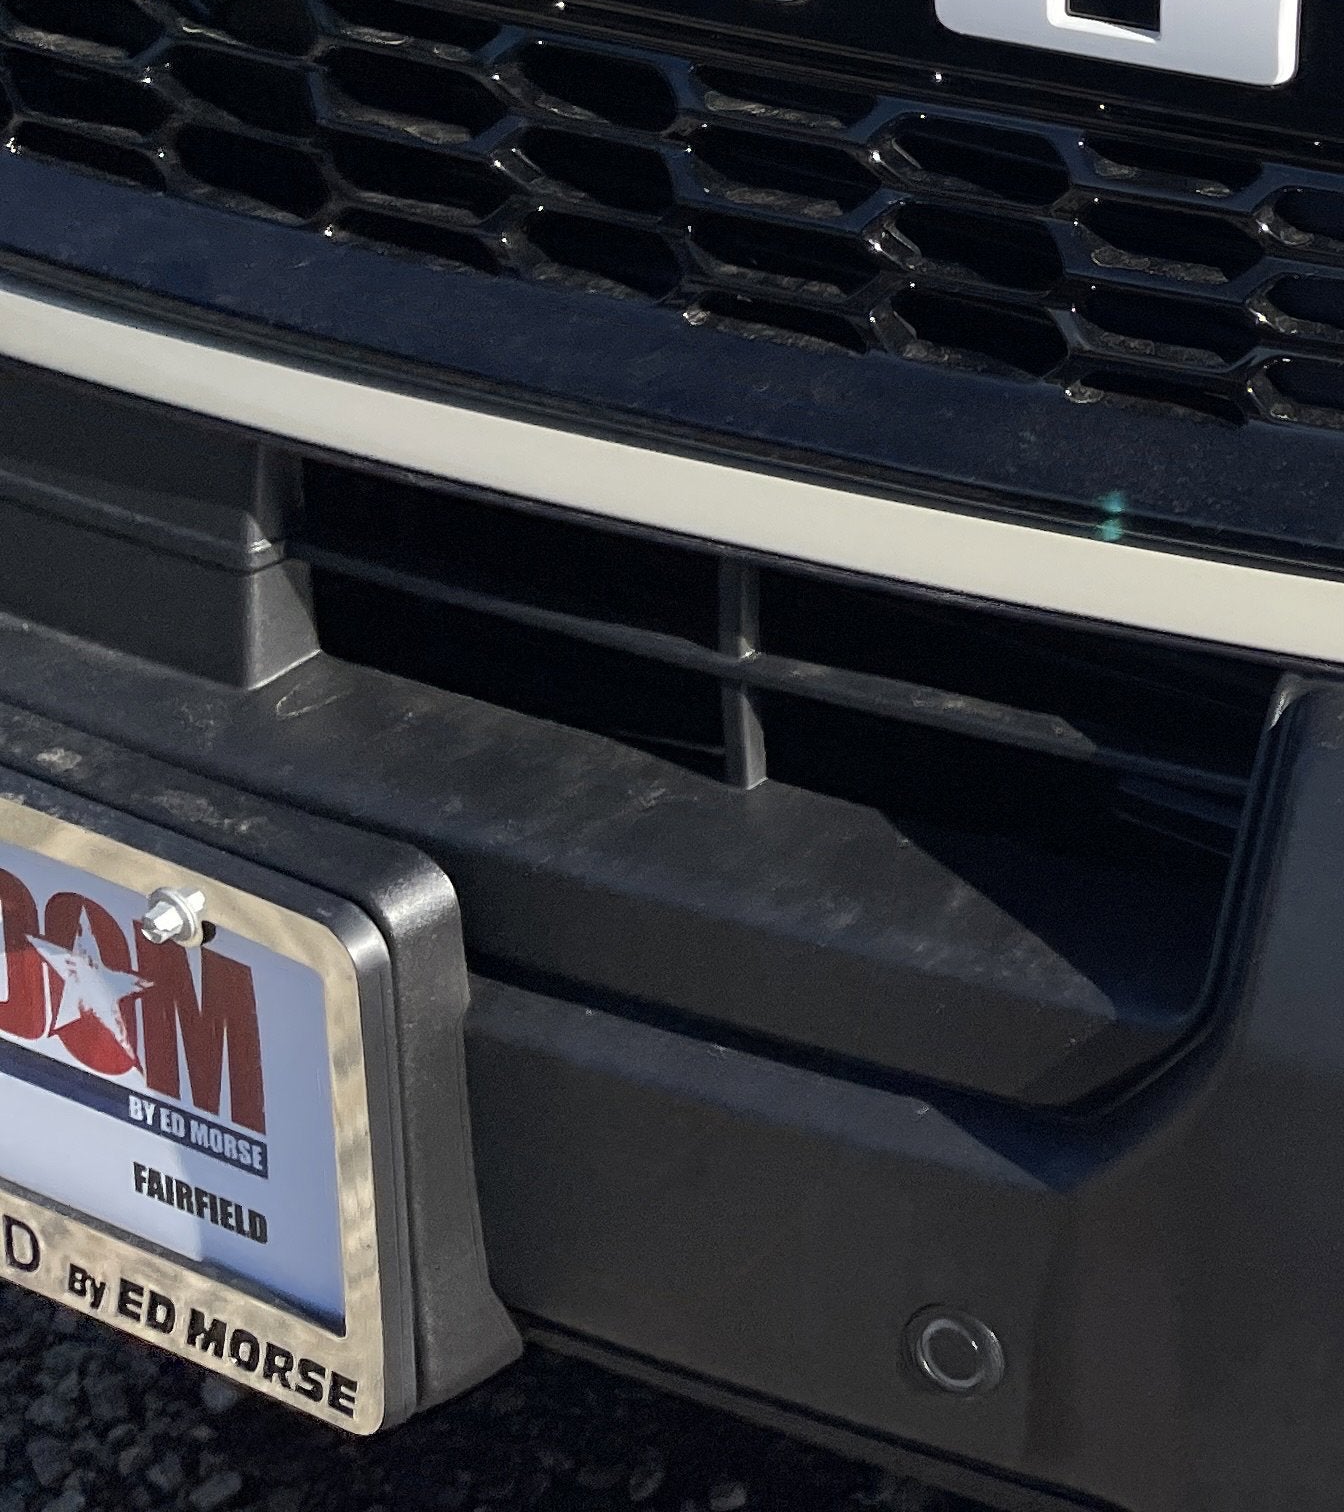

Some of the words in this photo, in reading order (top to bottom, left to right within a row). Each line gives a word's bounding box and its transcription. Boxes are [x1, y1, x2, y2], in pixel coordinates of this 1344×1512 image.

[128, 1094, 156, 1126] BY
[159, 1106, 186, 1138] ED
[189, 1119, 264, 1171] MORSE
[132, 1161, 268, 1245] FAIRFIELD
[117, 1276, 176, 1335] ED
[185, 1307, 359, 1419] MORSE
